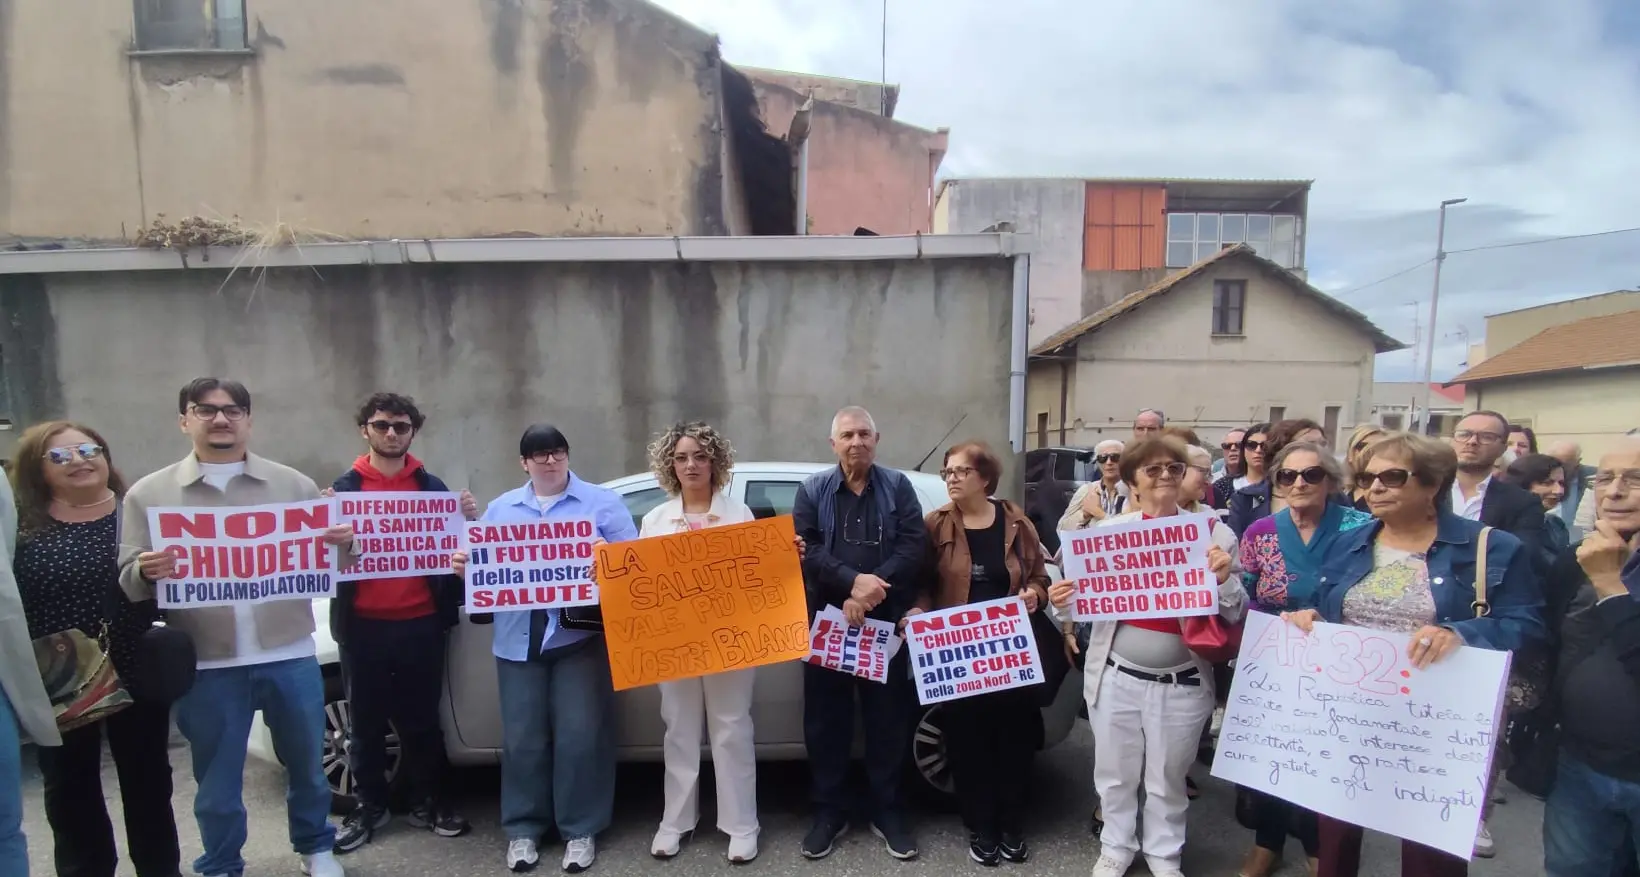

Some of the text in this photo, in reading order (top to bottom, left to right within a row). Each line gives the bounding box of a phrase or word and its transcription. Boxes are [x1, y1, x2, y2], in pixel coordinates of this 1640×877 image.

[158, 504, 329, 539] NON
[342, 498, 457, 515] DIFENDIAMO
[352, 517, 449, 534] LA SANITA'
[468, 520, 593, 544] SALVIAMO
[1072, 523, 1199, 556] DIFENDIAMO
[164, 535, 331, 580] CHIUDETE
[357, 535, 458, 554] UBBLICA di
[472, 542, 592, 565] il FUTURO
[600, 525, 792, 579] LA NOSTRA
[414, 554, 454, 570] NOR
[472, 565, 591, 586] della nostra
[1085, 547, 1191, 574] LA SANITA'
[166, 573, 331, 603] IL POLIAMBULATORIO
[472, 584, 593, 608] SALUTE
[629, 556, 764, 610] SALUTE
[1078, 568, 1205, 594] PUBBLICA di
[1077, 590, 1213, 615] REGGIO NORD
[610, 607, 685, 642] VALE
[911, 603, 1019, 634] NON
[876, 629, 889, 644] RC
[915, 619, 1021, 650] "CHIUDETECI"
[1249, 617, 1322, 673] Art.
[872, 652, 884, 677] Nord
[918, 635, 1028, 668] il DIRITTO
[922, 651, 1033, 684] alle CURE
[925, 685, 954, 699] nella
[957, 680, 982, 694] zona
[984, 672, 1012, 687] Nord
[1019, 668, 1034, 681] RC
[1298, 676, 1389, 713] Repulica
[1328, 707, 1432, 738] fondamentale
[1224, 751, 1257, 763] cure
[1269, 759, 1318, 786] gatuite
